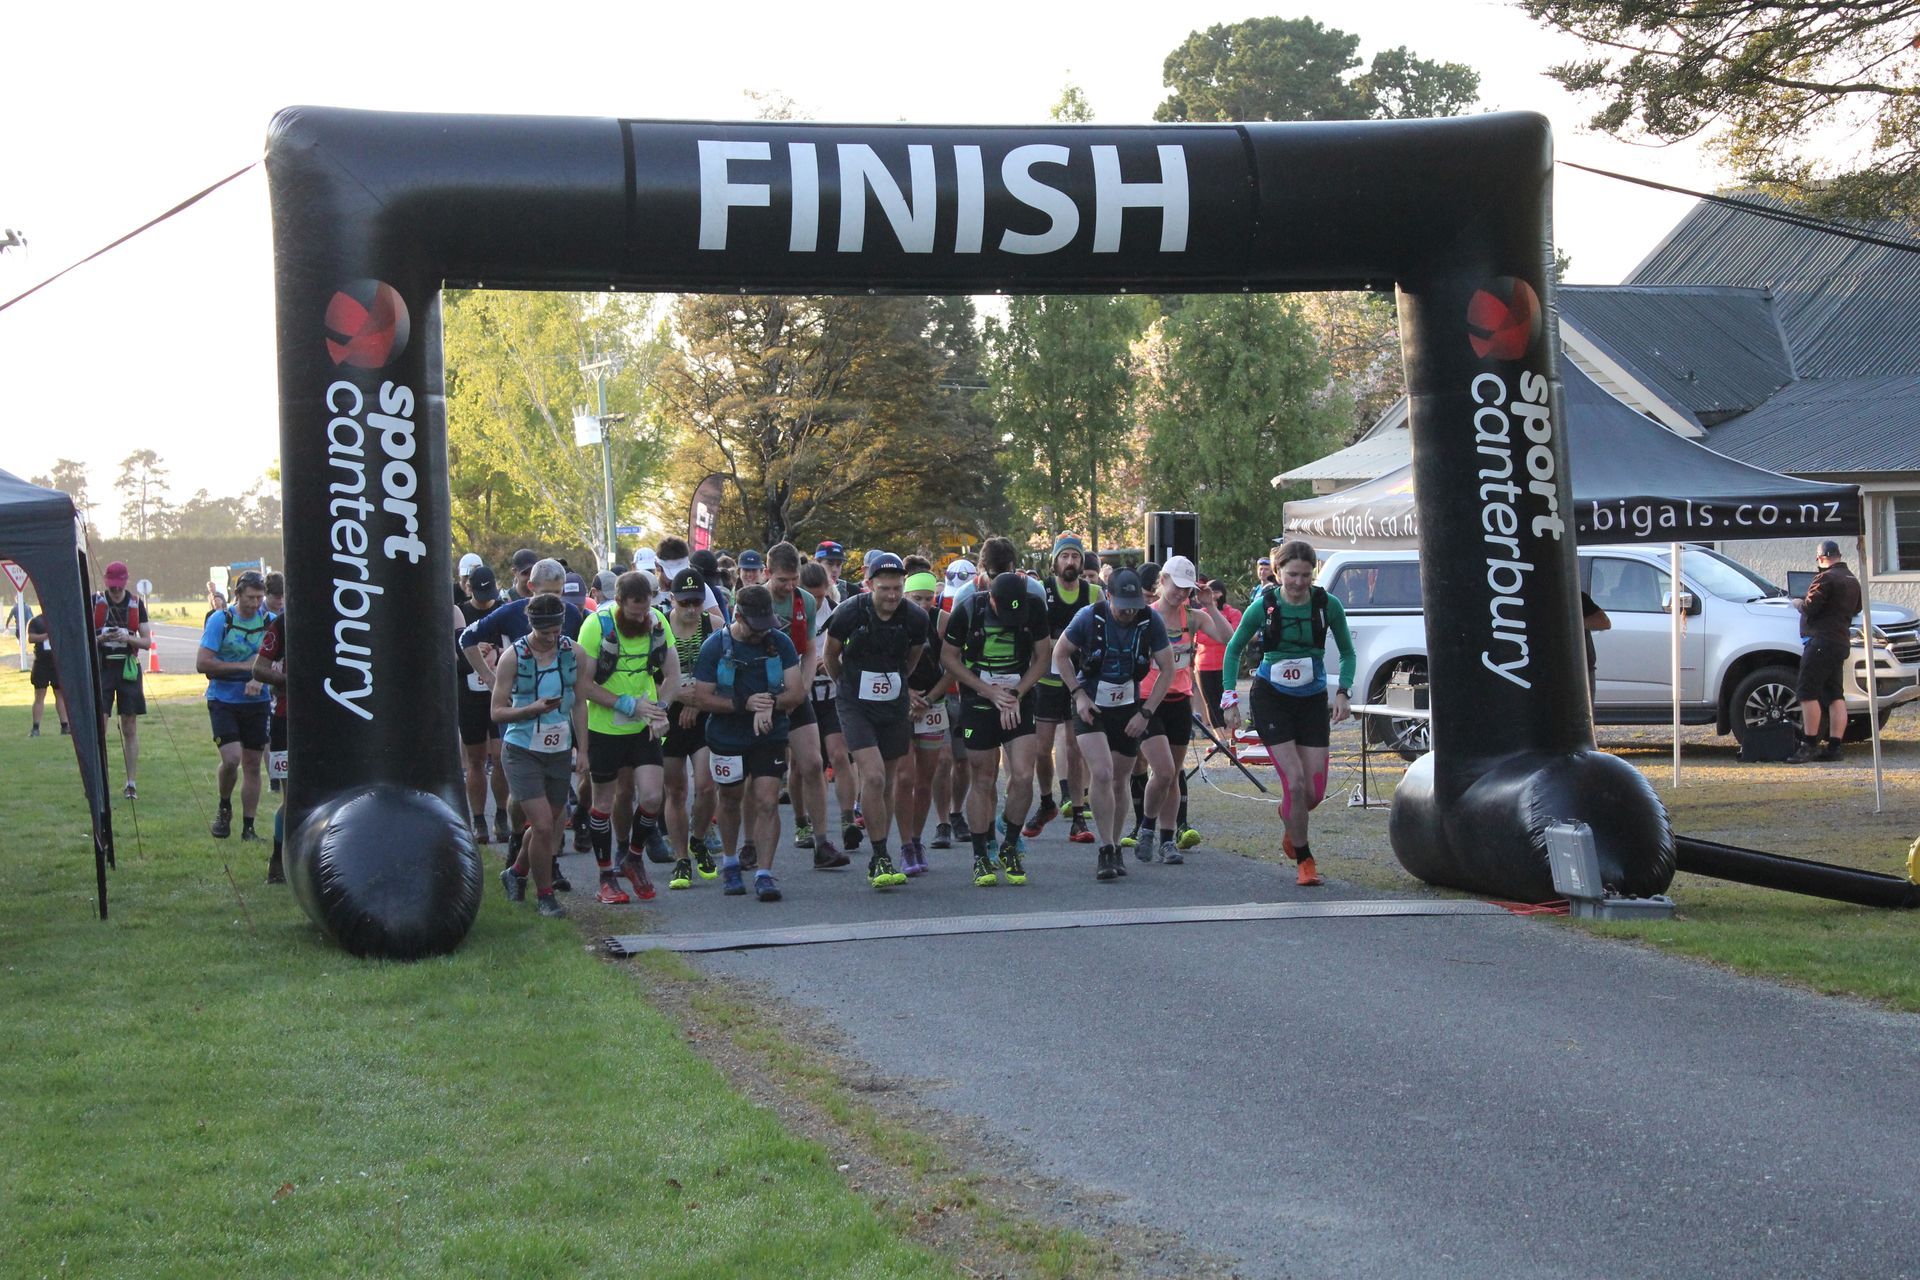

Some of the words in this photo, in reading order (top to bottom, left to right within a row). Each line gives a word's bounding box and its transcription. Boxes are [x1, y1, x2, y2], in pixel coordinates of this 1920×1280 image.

[698, 139, 1190, 255] FINISH
[1510, 369, 1565, 541] sport
[366, 380, 427, 564] sport
[1579, 499, 1842, 537] .bigals.co.nz
[1471, 371, 1535, 690] canterbury
[323, 380, 385, 721] canterbury
[1282, 668, 1301, 680] 40
[872, 682, 890, 694] 55
[1109, 692, 1124, 702] 14
[926, 713, 942, 726] 30
[544, 733, 560, 746] 63
[274, 760, 288, 772] 49
[715, 764, 730, 777] 66
